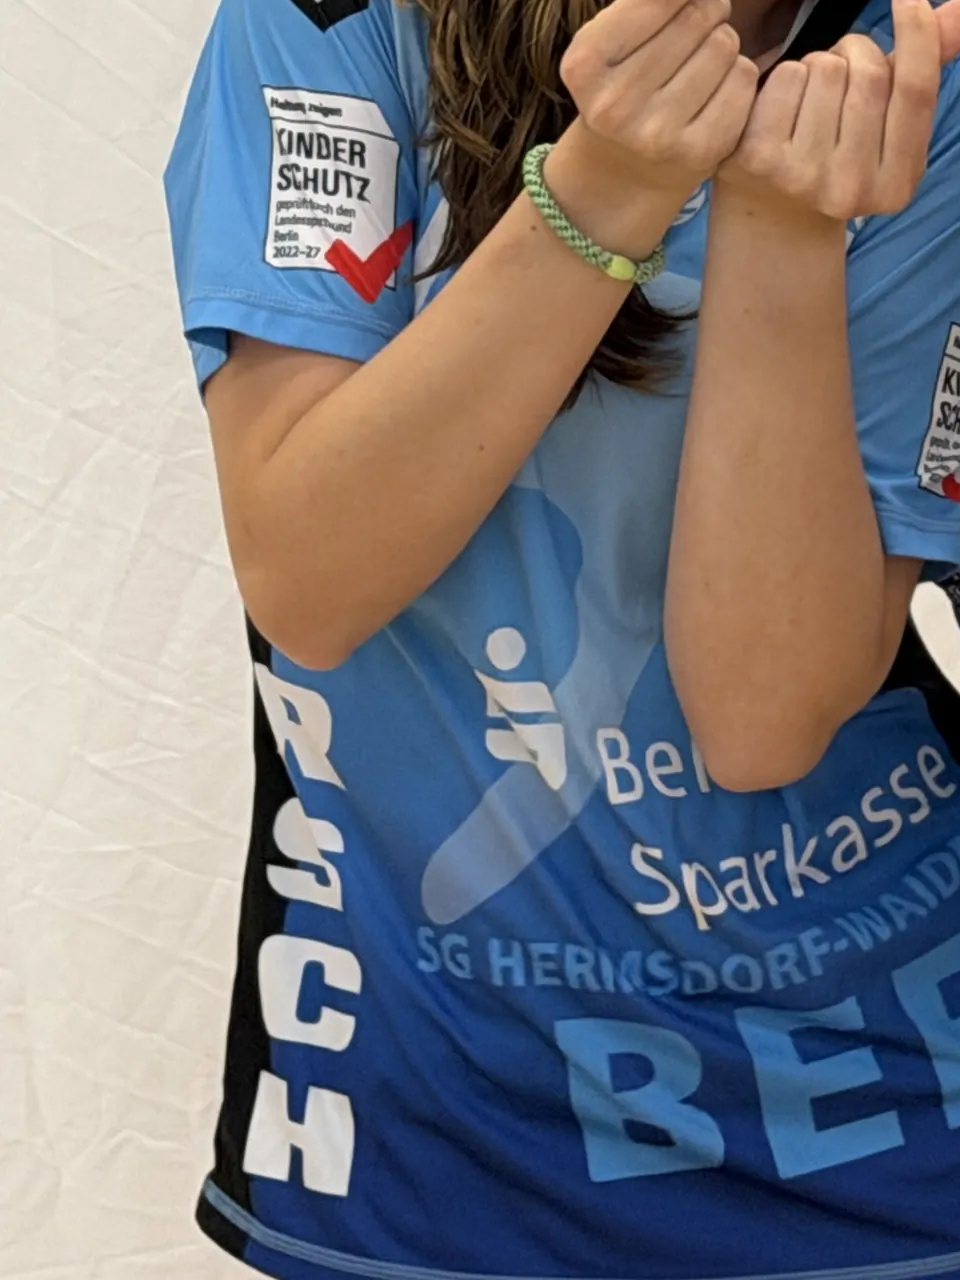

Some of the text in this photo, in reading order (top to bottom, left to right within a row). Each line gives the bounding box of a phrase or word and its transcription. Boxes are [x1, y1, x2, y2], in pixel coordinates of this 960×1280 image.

[275, 128, 367, 168] KINDER
[276, 163, 371, 204] SCHUTZ
[628, 743, 957, 931] Sparkasse
[416, 925, 474, 981] SG
